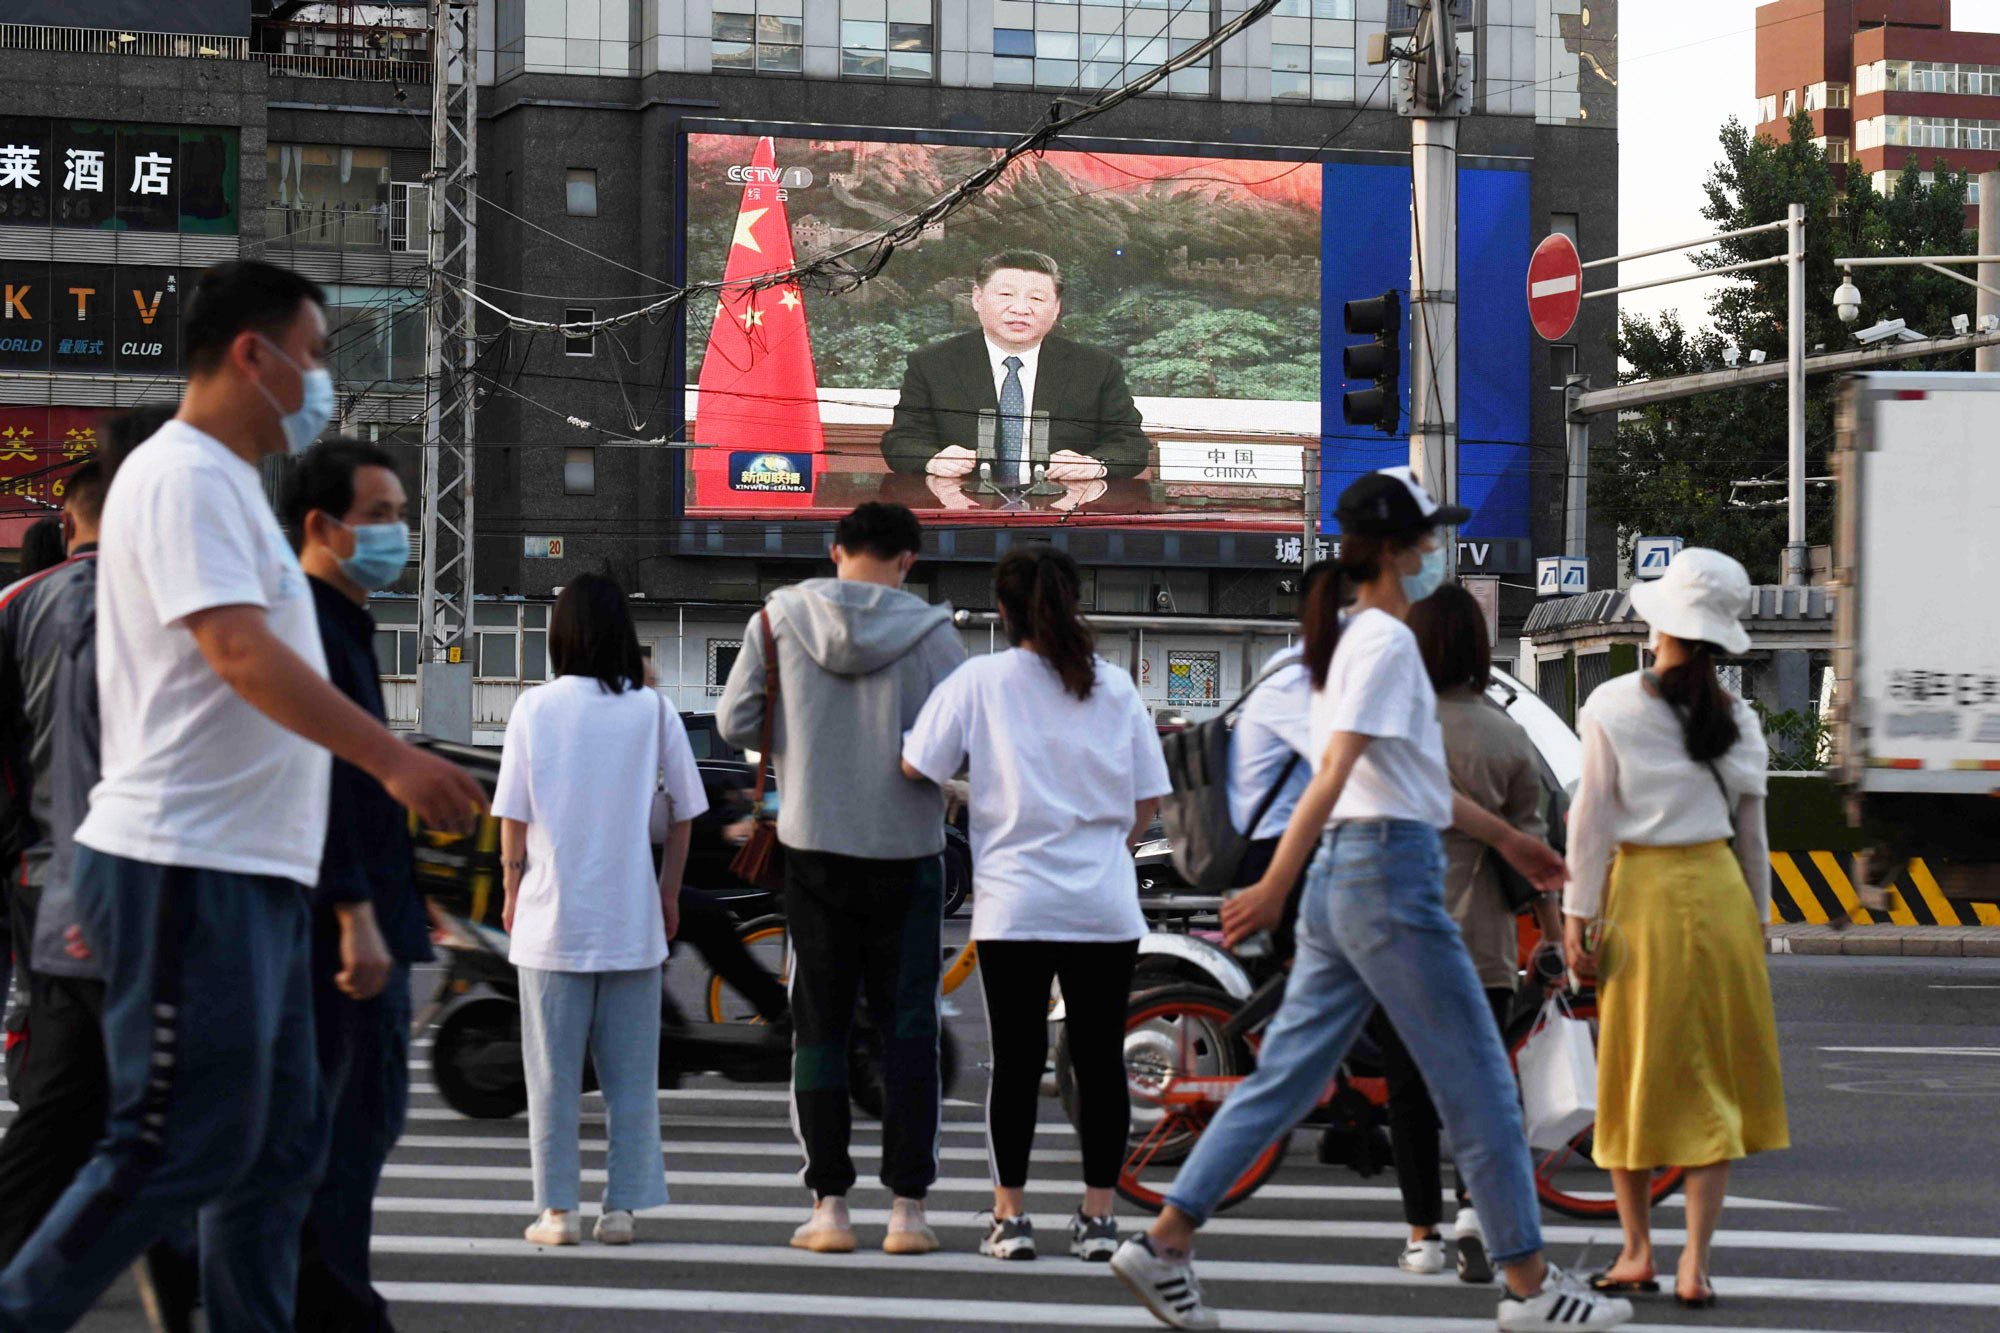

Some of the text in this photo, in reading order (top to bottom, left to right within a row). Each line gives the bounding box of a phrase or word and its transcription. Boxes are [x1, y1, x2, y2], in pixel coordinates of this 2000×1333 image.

[0, 144, 173, 195] 莱酒店
[727, 165, 782, 182] CCTV
[747, 188, 788, 201] 综合
[0, 337, 163, 355] ORLD 量贩式 CLUB
[1208, 448, 1253, 464] 中国
[741, 470, 800, 484] 新闻联播
[1203, 467, 1257, 479] CHINA
[549, 540, 561, 555] 20
